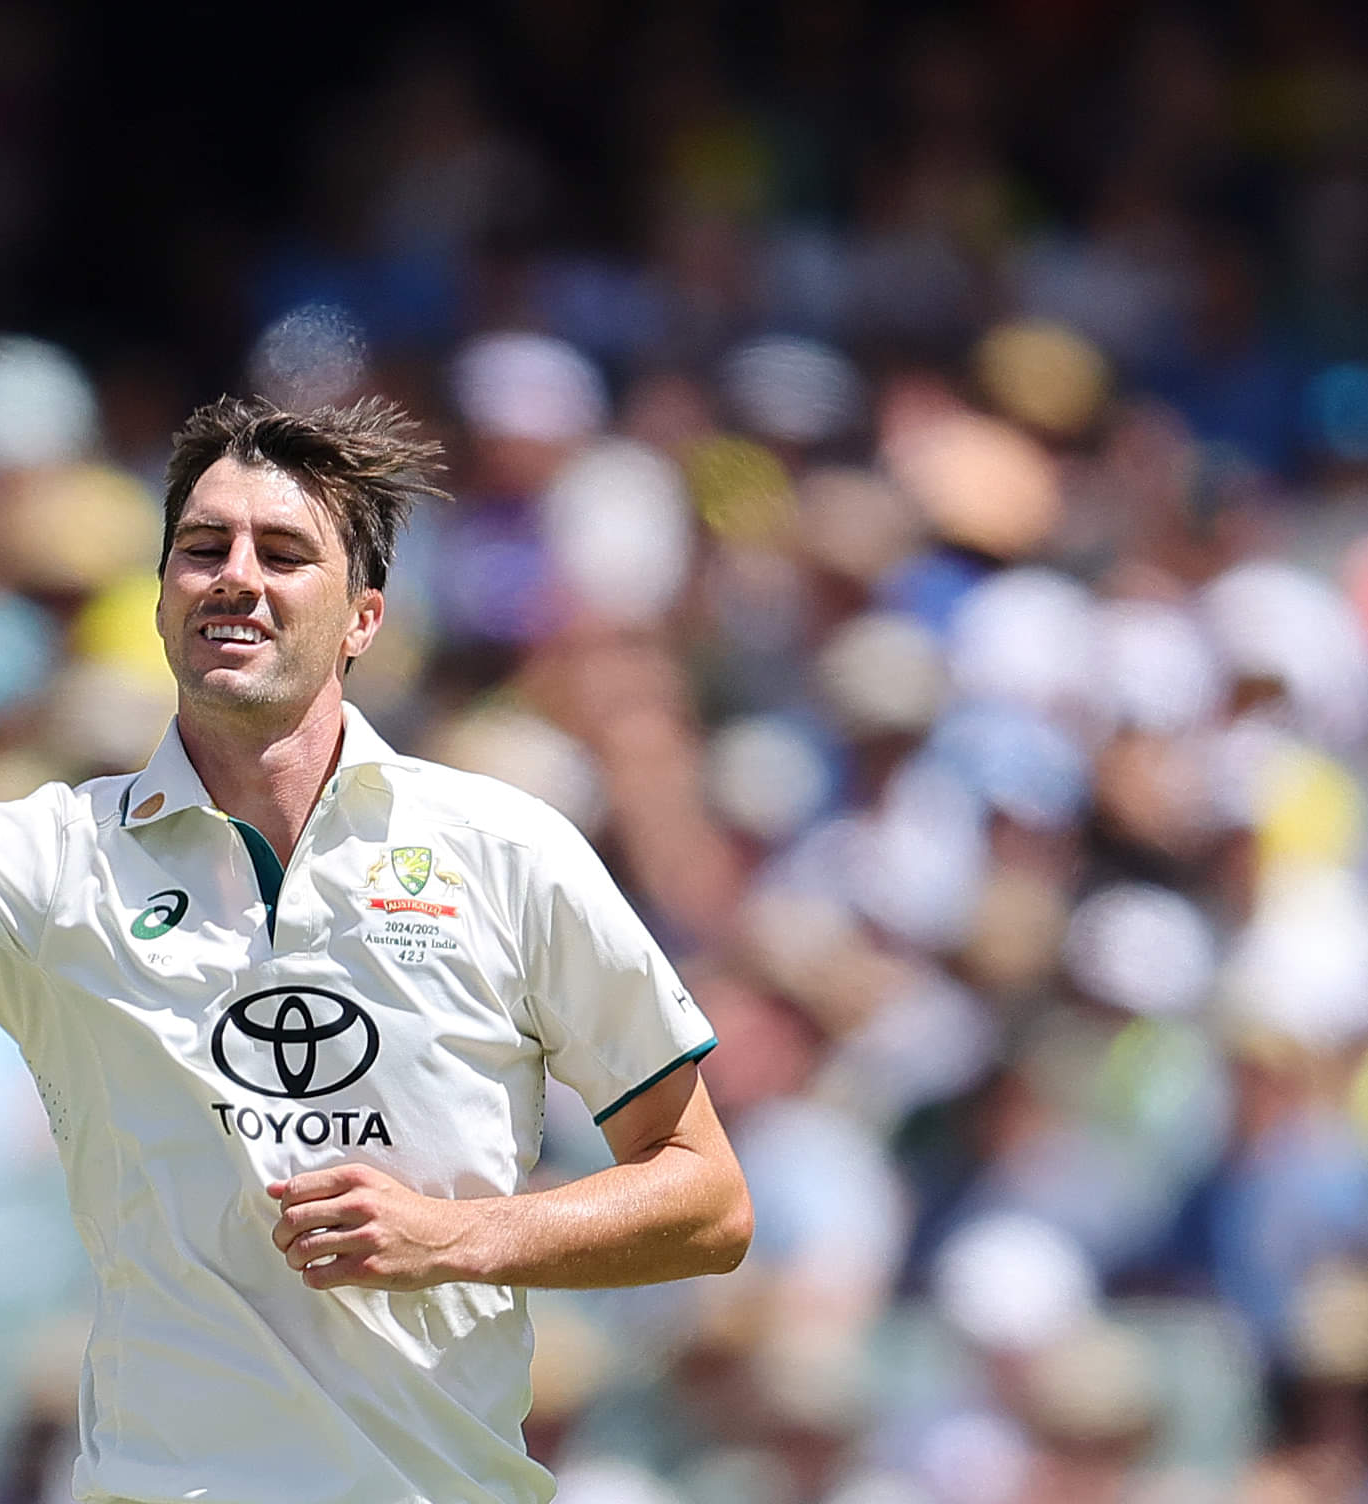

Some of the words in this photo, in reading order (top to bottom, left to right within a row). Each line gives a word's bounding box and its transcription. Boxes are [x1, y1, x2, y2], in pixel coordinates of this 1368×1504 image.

[385, 921, 440, 935] 2024/2025
[365, 933, 412, 947] Australia
[416, 940, 427, 949] vs
[431, 939, 457, 950] India
[398, 950, 425, 963] 423
[211, 1102, 393, 1146] TOYOTA
